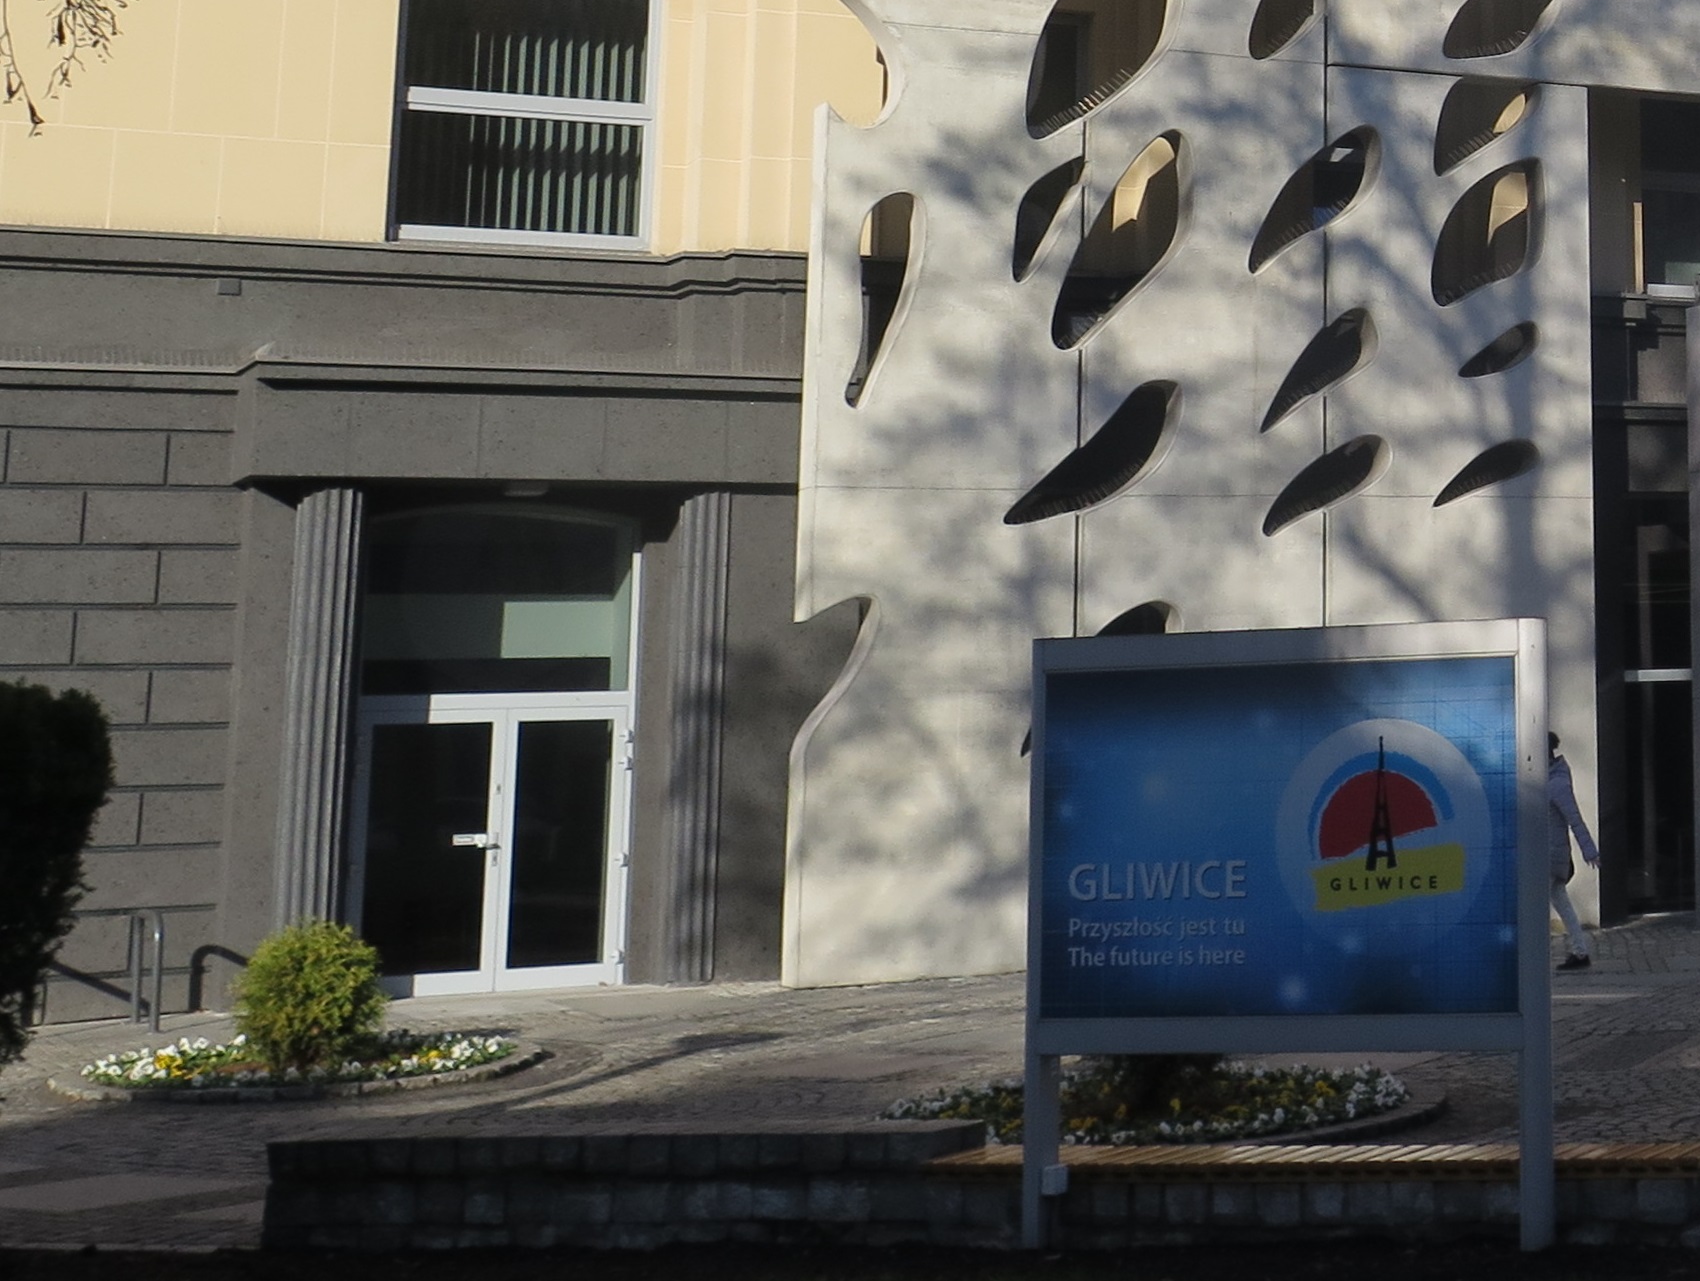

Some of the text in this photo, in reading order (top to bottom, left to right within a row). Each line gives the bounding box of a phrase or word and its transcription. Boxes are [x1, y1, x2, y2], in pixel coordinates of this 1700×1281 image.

[1068, 860, 1249, 902] GLIWICE
[1330, 875, 1438, 891] GLIWICE
[1068, 916, 1247, 943] Przyszłość jest tu
[1068, 946, 1246, 967] The future is here
